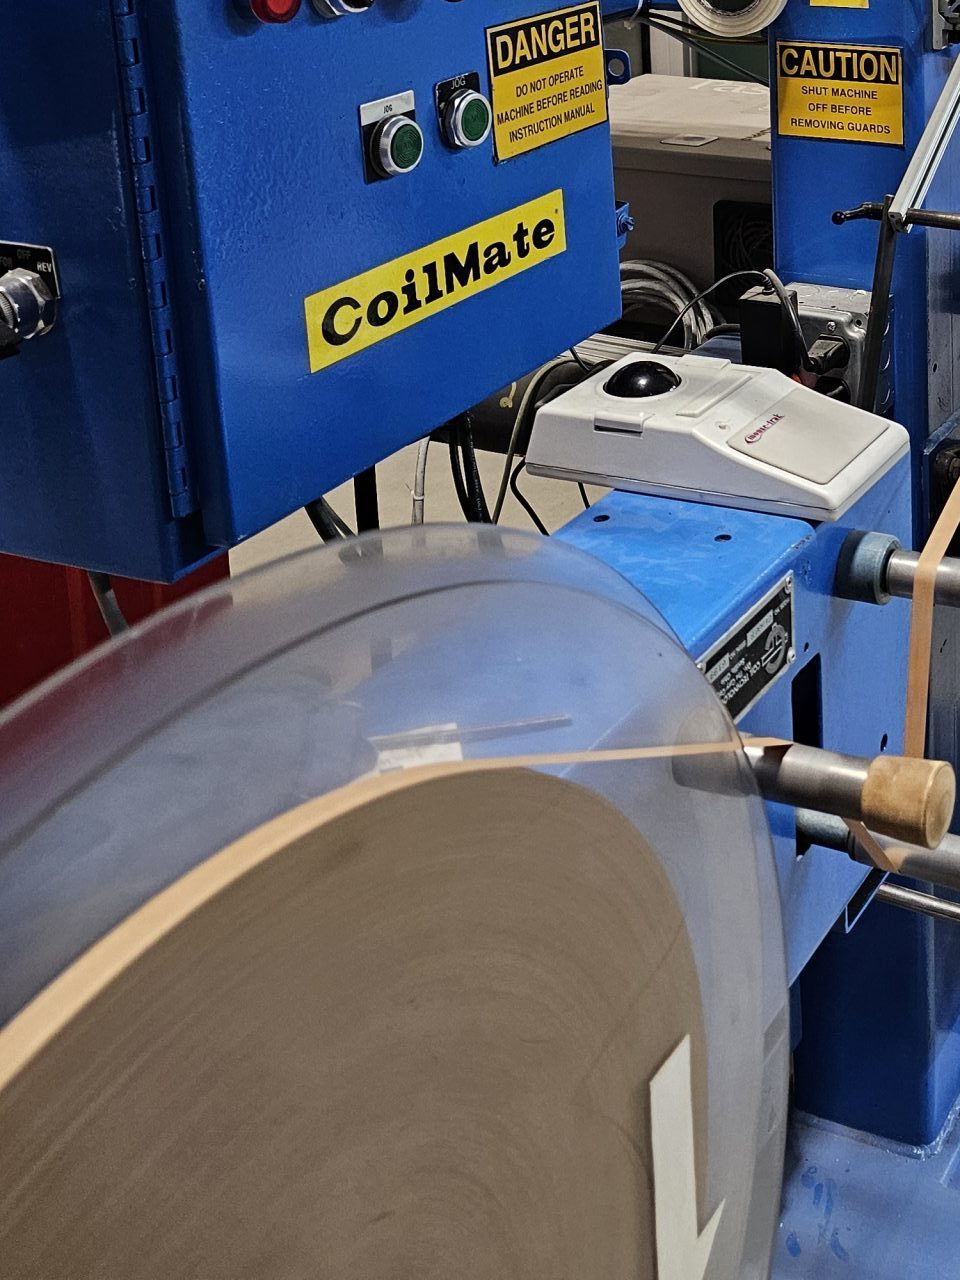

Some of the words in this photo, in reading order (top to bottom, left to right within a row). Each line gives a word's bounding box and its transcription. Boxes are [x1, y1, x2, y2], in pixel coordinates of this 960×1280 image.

[495, 11, 596, 70] DANGER
[781, 48, 897, 82] CAUTION
[450, 76, 466, 90] JOG
[516, 83, 528, 98] DO
[530, 79, 548, 94] NOT
[549, 65, 584, 87] OPERATE
[801, 85, 829, 97] SHUT
[831, 88, 878, 100] MACHINE
[383, 104, 393, 114] JOG
[496, 103, 535, 125] MACHINE
[536, 92, 568, 112] BEFORE
[570, 79, 603, 101] READING
[808, 102, 828, 112] OFF
[830, 104, 872, 116] BEFORE
[509, 114, 563, 143] INSTRUCTION
[564, 102, 595, 123] MANUAL
[790, 117, 845, 131] REMOVING
[847, 122, 891, 135] GUARDS
[36, 261, 52, 273] REV
[321, 218, 555, 346] CoilMate
